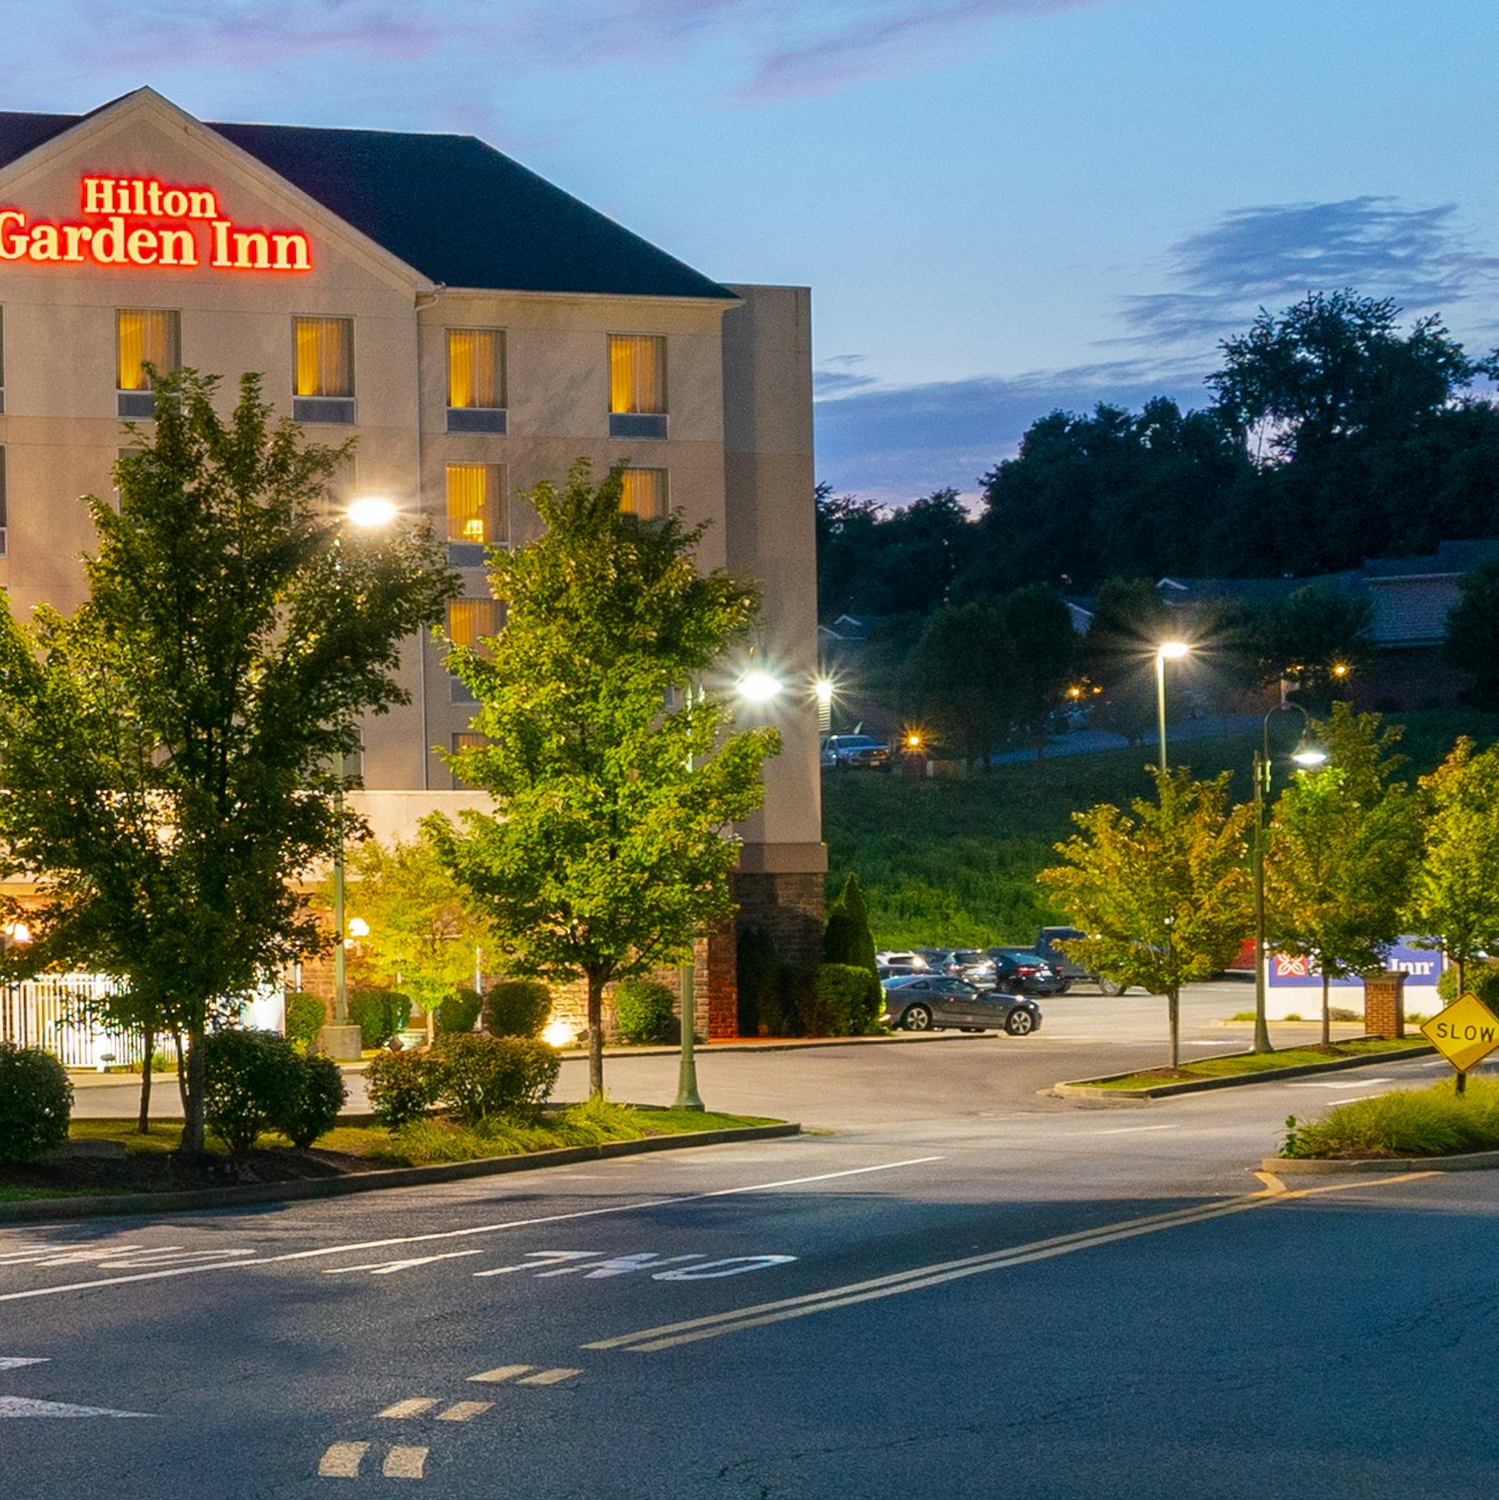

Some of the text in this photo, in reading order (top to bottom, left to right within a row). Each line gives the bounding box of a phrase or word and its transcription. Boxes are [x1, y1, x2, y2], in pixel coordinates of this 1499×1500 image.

[83, 178, 217, 218] Hilton
[212, 220, 312, 270] Inn
[1390, 958, 1431, 976] Inn
[1436, 1022, 1495, 1043] SLOW
[321, 1249, 799, 1281] ONLY
